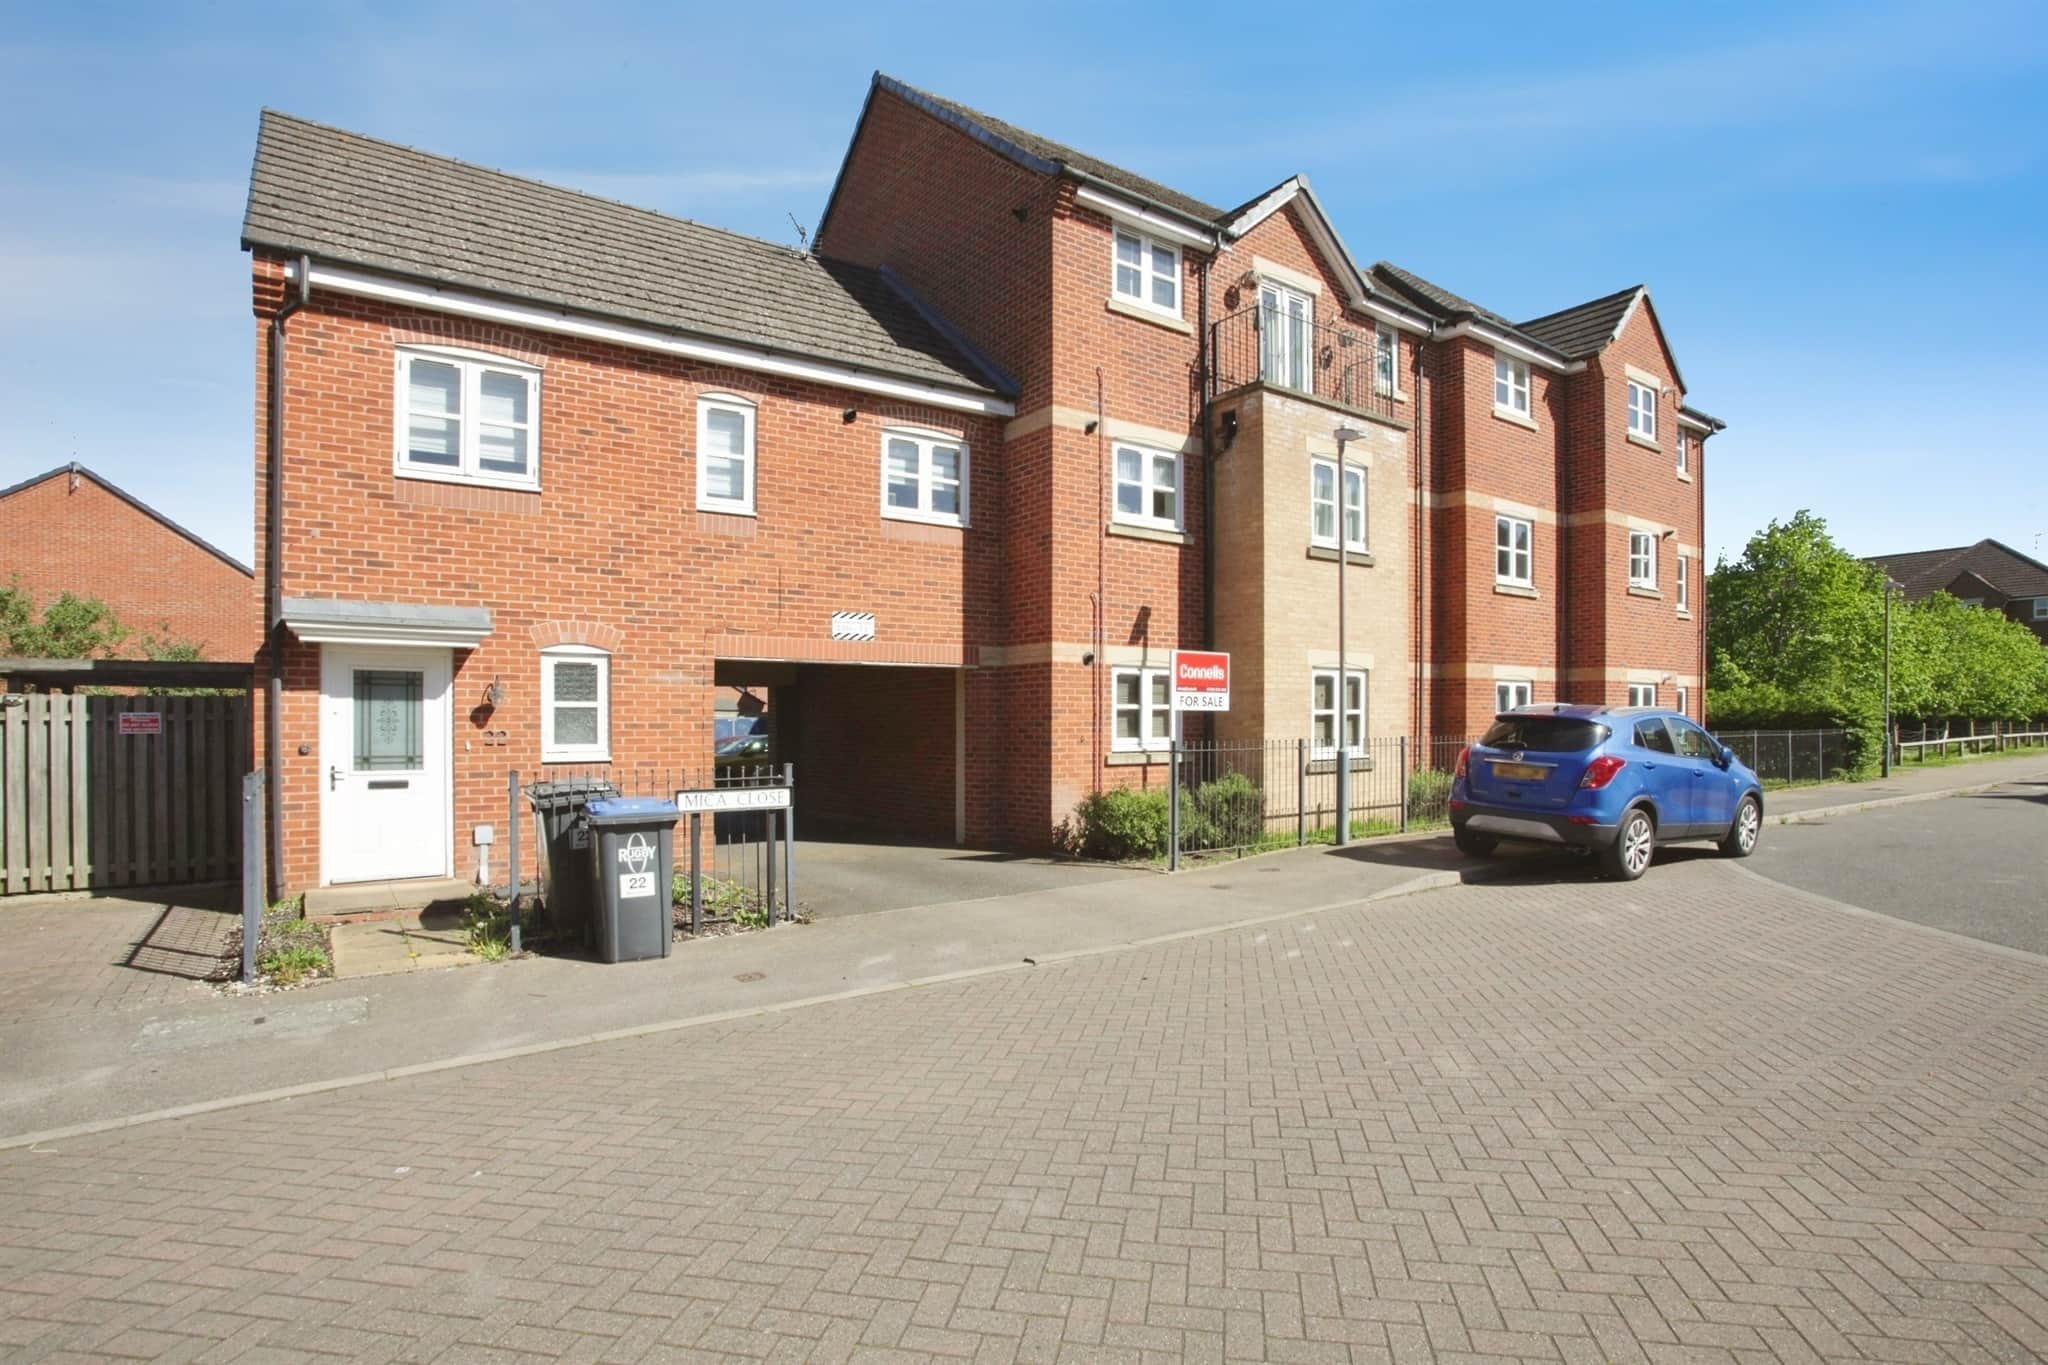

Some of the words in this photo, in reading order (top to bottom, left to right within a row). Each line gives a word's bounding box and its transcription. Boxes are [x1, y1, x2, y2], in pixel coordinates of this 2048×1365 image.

[1180, 663, 1224, 680] Connells
[1179, 695, 1199, 706] FOR
[1202, 696, 1223, 707] SALE
[684, 793, 727, 809] MICA
[737, 790, 785, 806] CLOSE
[618, 845, 656, 863] RUGBY
[629, 876, 647, 889] 22
